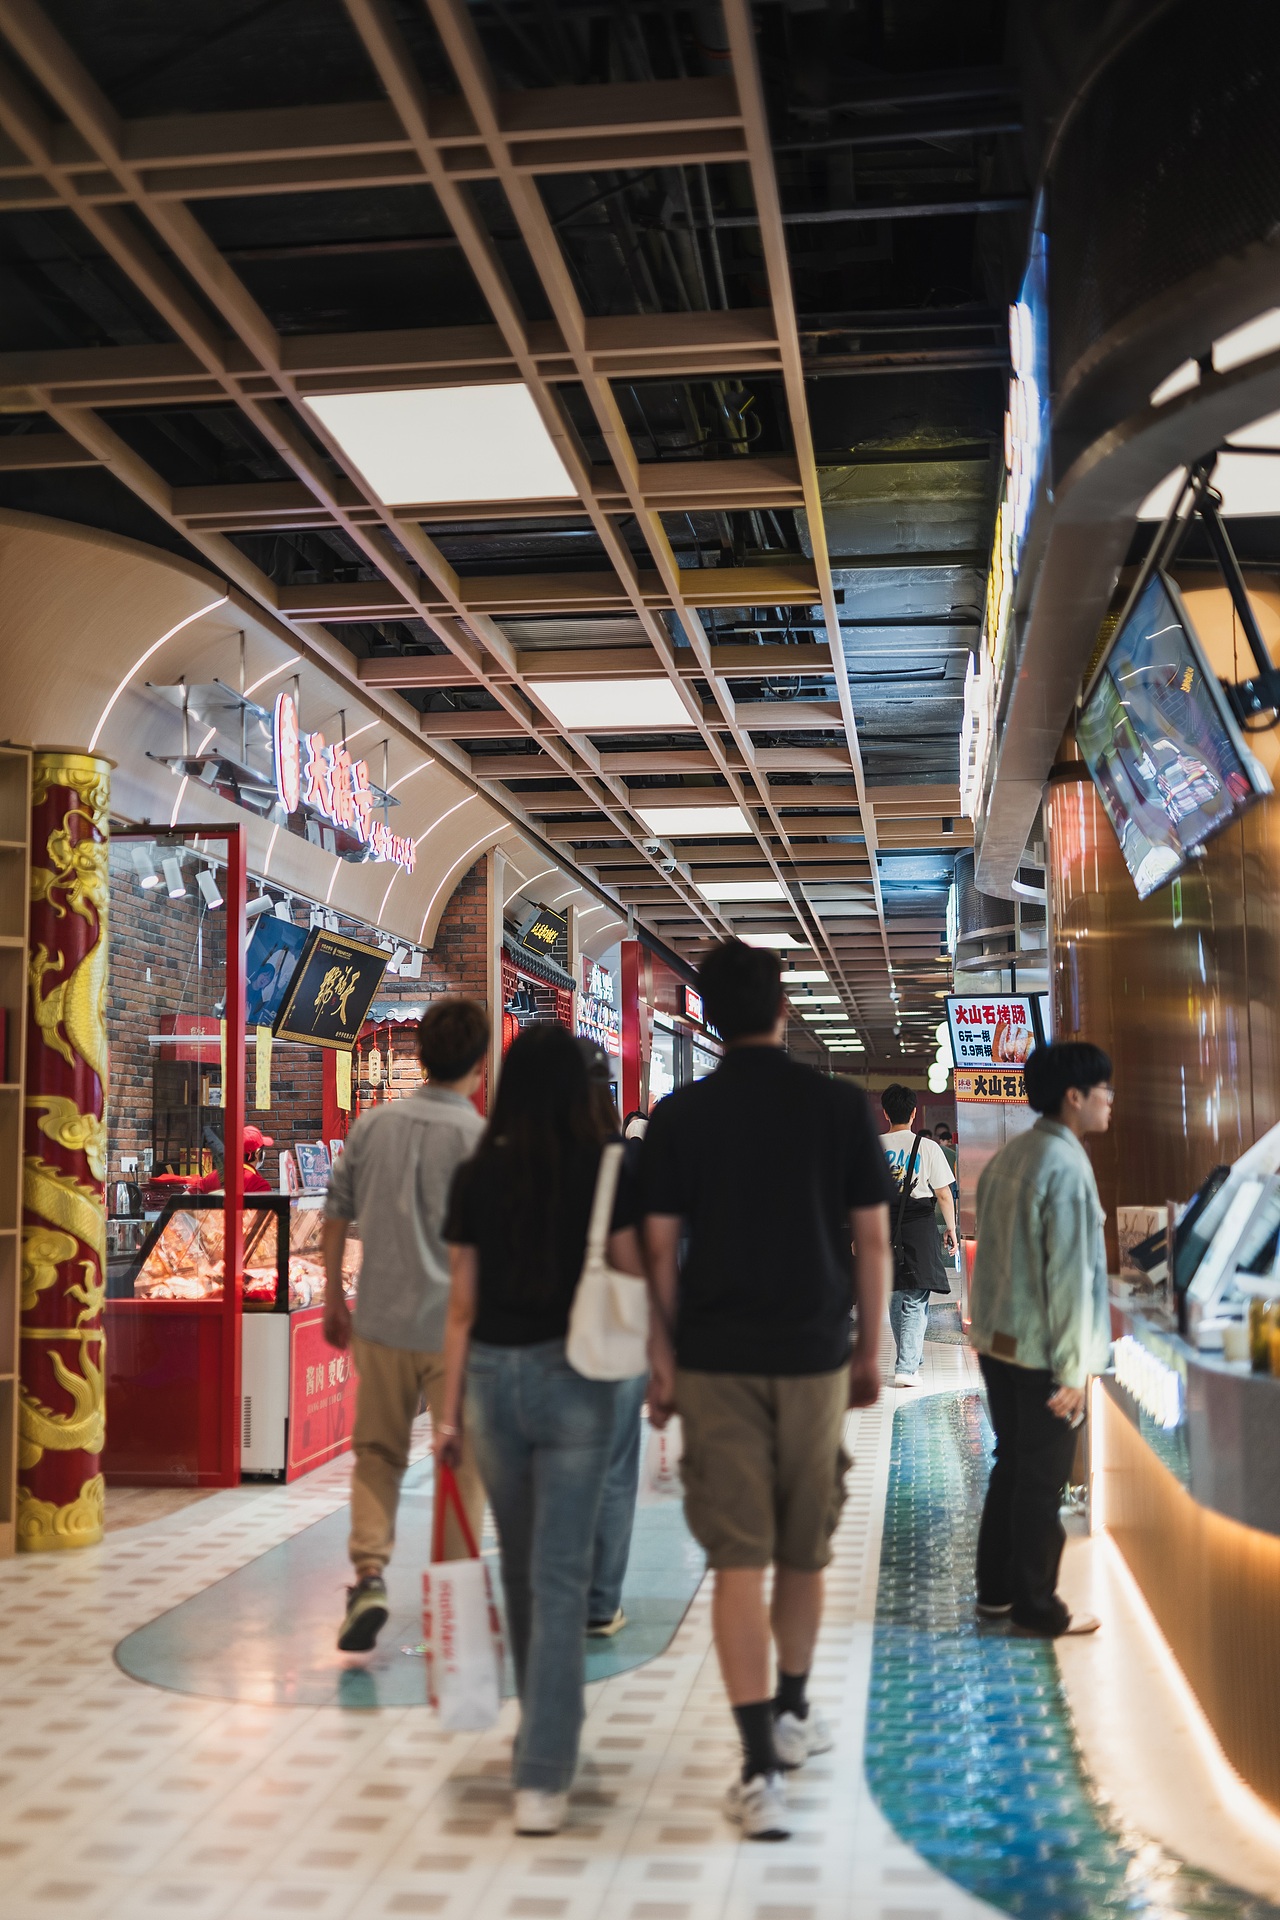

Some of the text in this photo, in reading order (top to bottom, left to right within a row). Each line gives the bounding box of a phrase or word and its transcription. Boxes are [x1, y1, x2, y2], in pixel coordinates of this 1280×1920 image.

[954, 1004, 1026, 1025] 火山石烤肠
[958, 1029, 992, 1043] 6元一根
[961, 1044, 993, 1057] 9.9两根
[306, 1363, 324, 1397] 酱肉
[328, 1354, 358, 1388] 要吃天
